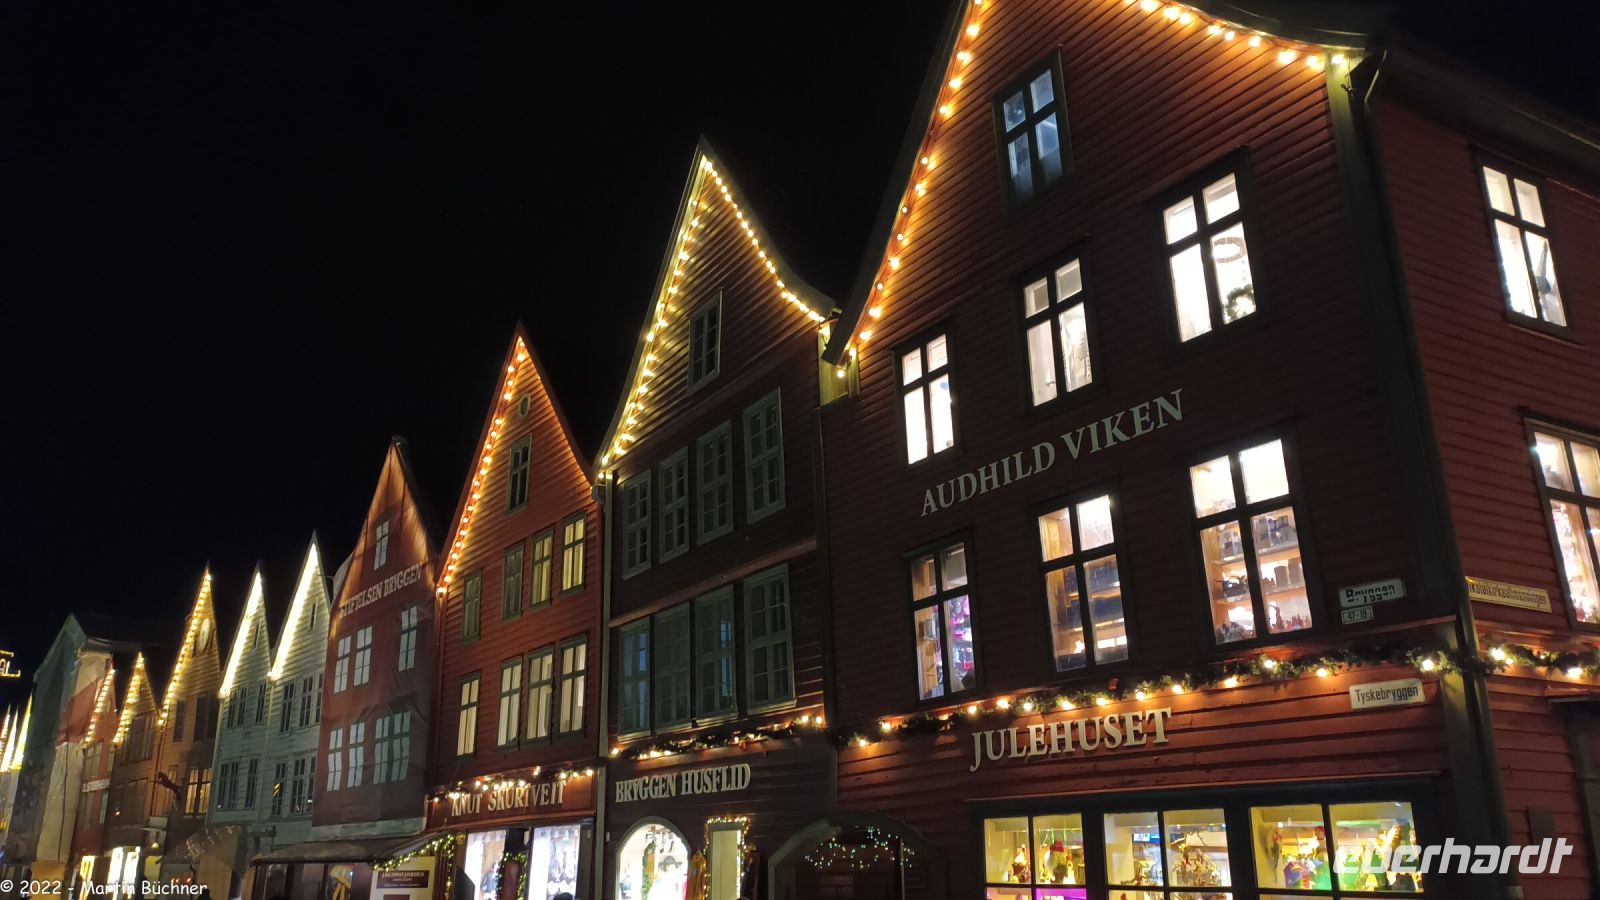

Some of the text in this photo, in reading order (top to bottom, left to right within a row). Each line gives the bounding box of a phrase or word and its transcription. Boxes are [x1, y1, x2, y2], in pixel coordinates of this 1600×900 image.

[921, 388, 1184, 518] AUDHILD VIKEN
[339, 562, 422, 618] STIFTELSEN BRYGGEN
[1345, 584, 1396, 603] Bryggen
[1354, 686, 1419, 705] Tyskebryggen
[969, 707, 1171, 772] JULEHUSET
[615, 762, 751, 803] BRYGGEN HUSFLID
